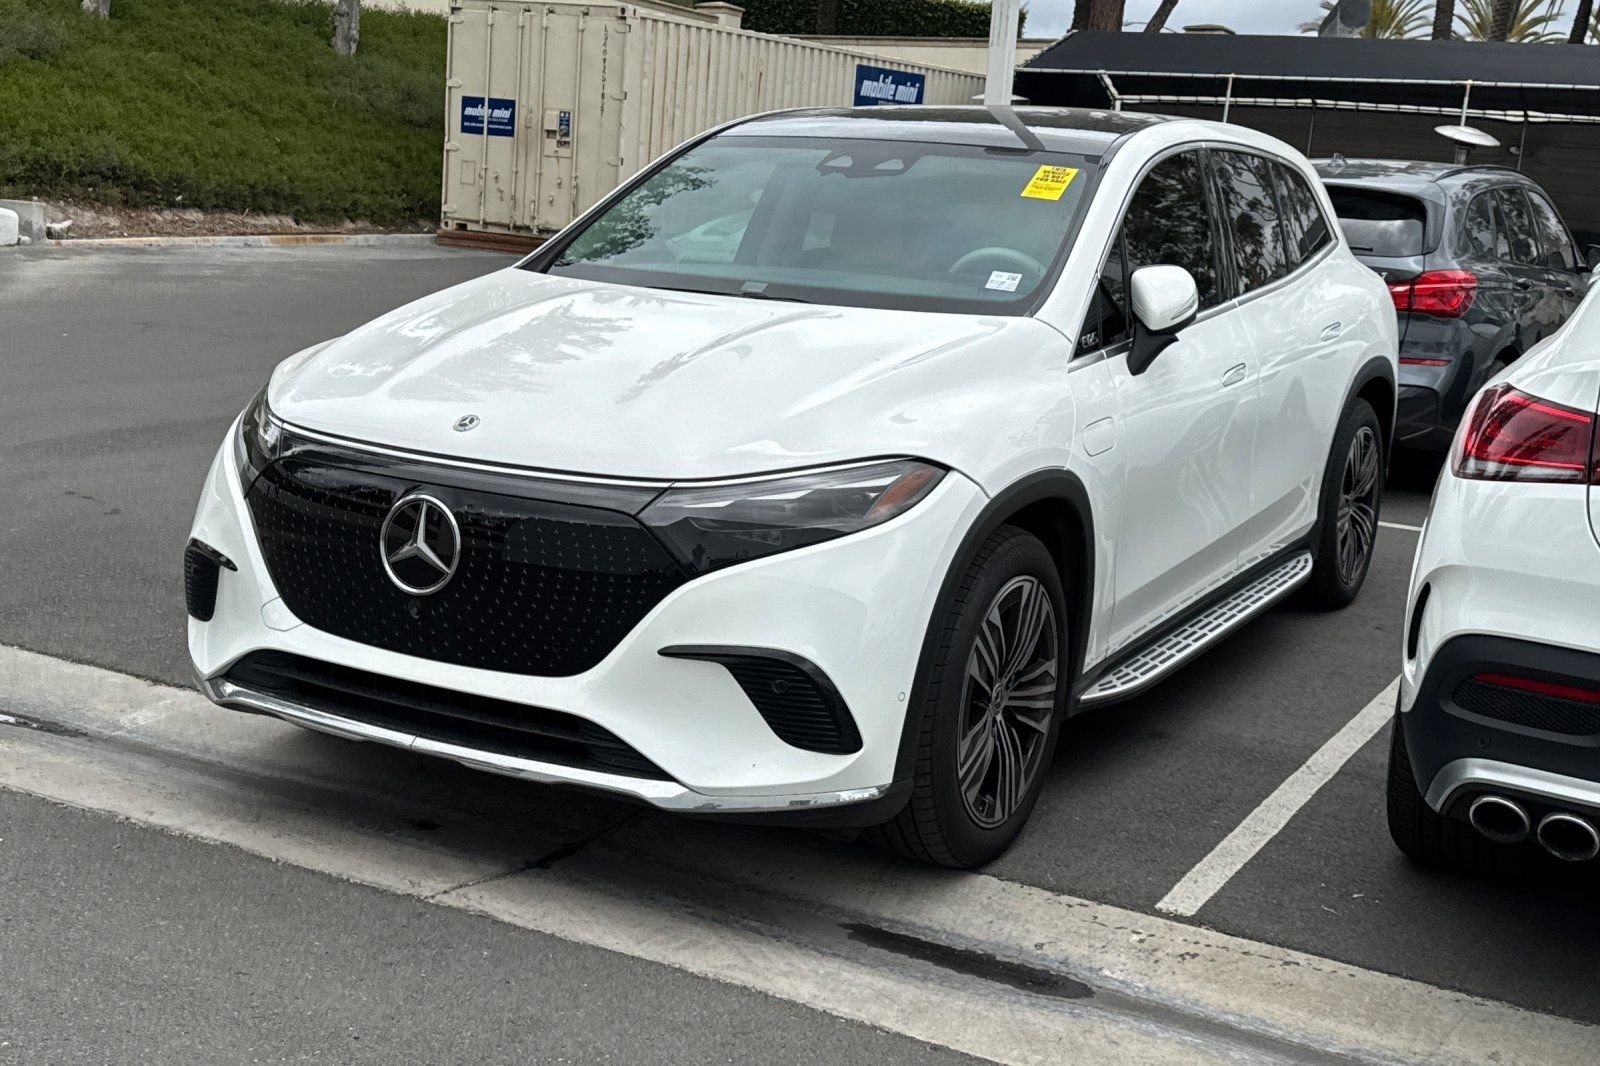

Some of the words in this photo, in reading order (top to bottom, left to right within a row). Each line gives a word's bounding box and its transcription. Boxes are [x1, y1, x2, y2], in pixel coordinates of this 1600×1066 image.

[860, 74, 896, 100] mobile
[895, 81, 920, 103] mini
[492, 107, 512, 119] mini
